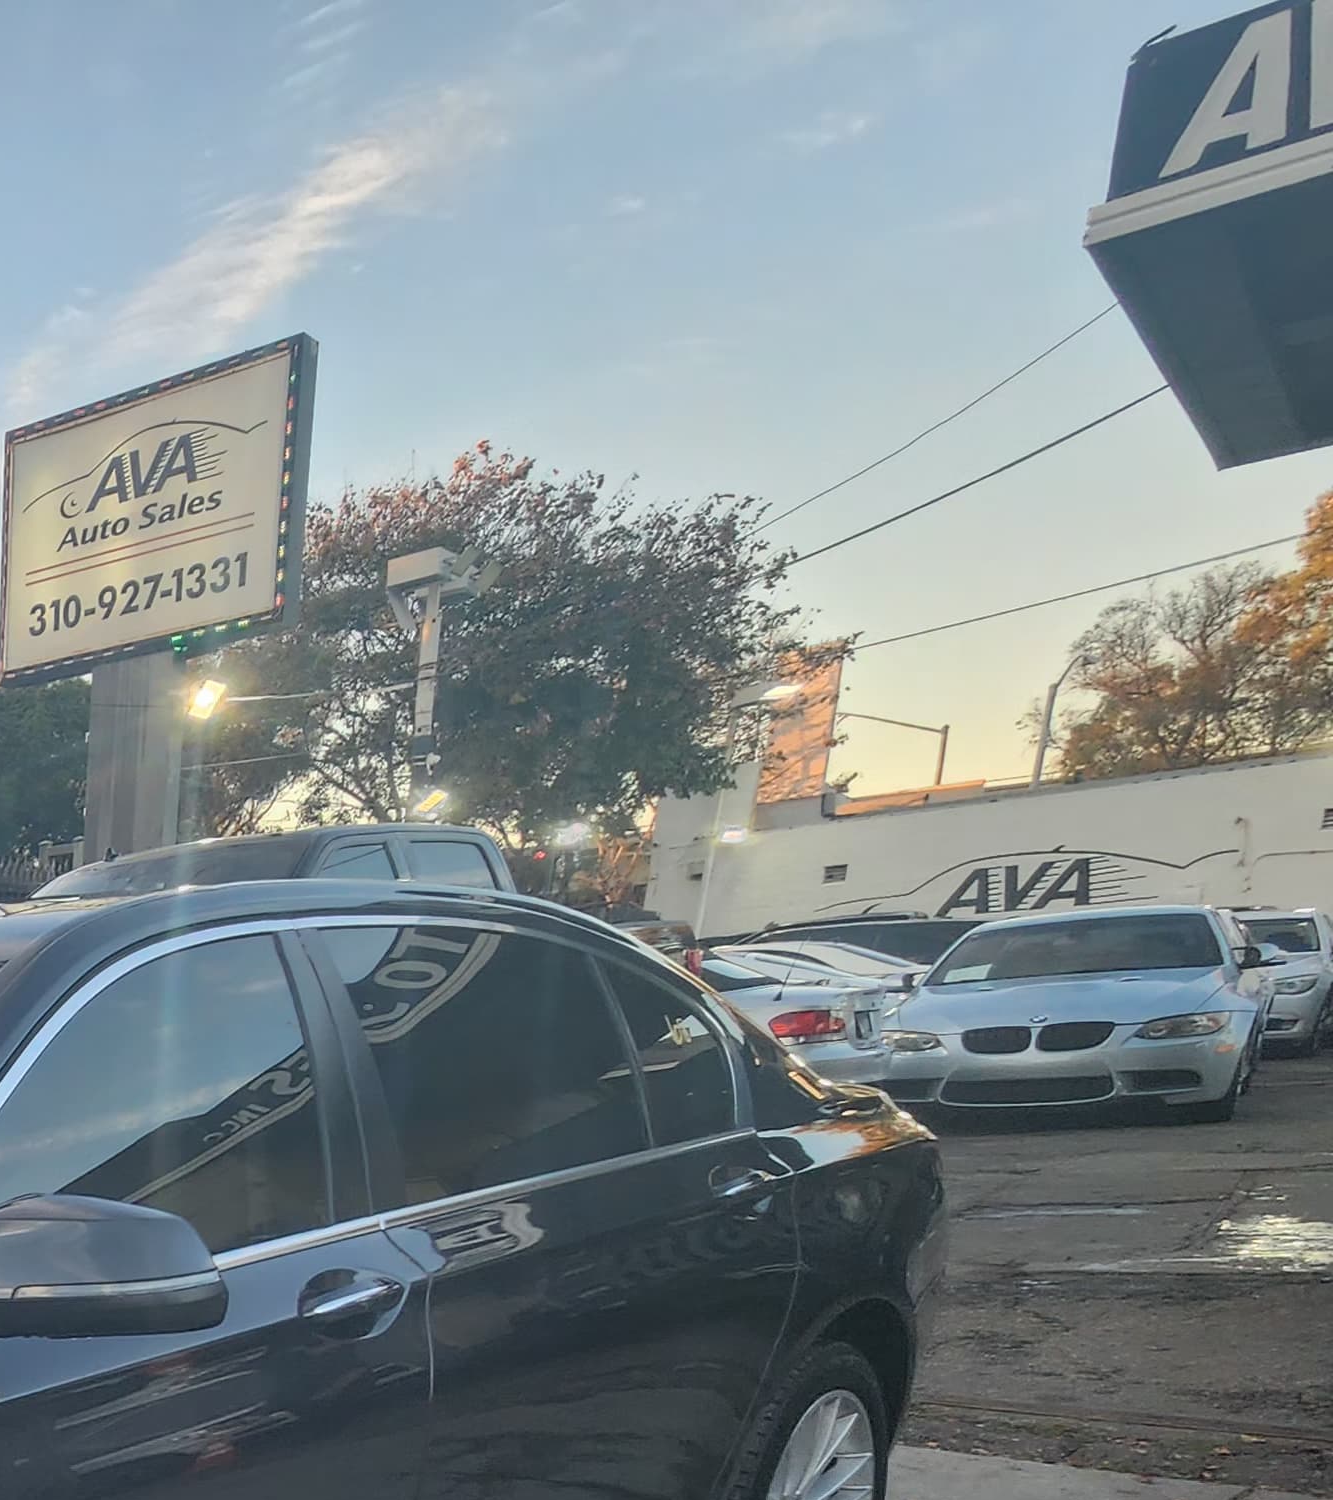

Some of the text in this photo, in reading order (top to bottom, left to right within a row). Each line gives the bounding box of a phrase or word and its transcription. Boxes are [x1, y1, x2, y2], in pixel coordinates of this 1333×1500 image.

[1158, 0, 1333, 178] A
[85, 430, 205, 513] AVA
[56, 490, 223, 552] Auto Sales
[28, 552, 249, 637] 310-927-1331
[935, 856, 1097, 917] AVA
